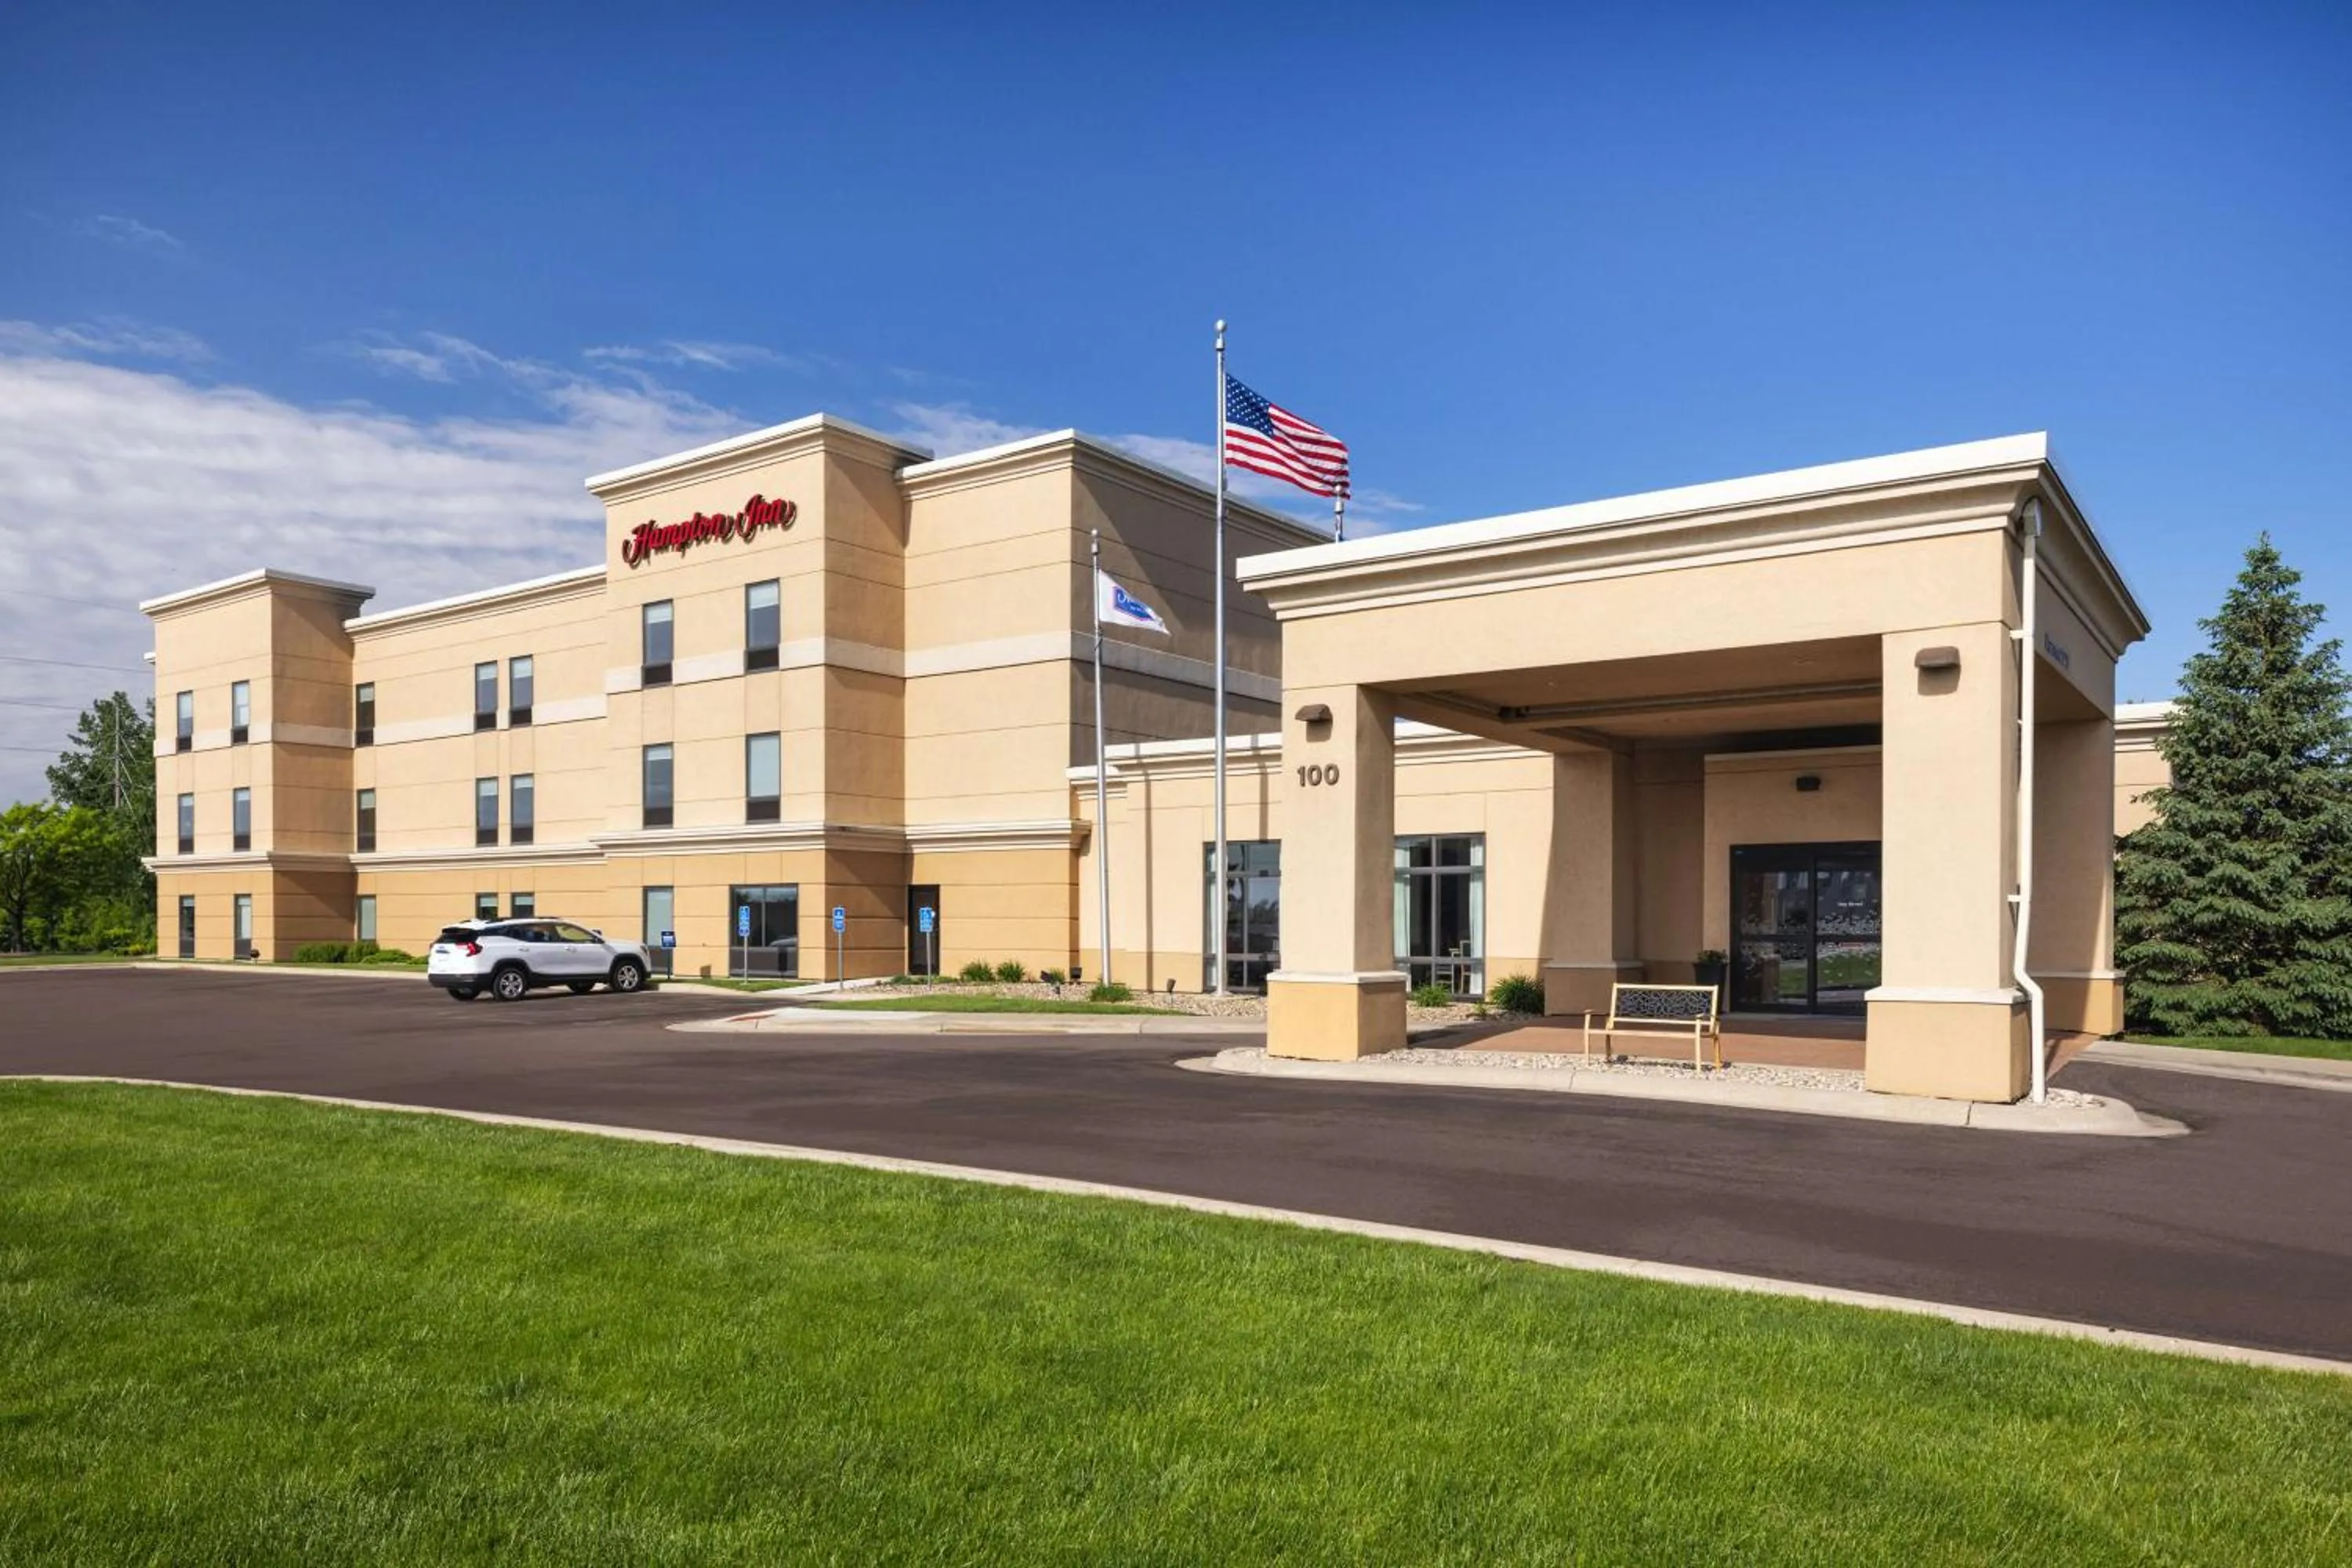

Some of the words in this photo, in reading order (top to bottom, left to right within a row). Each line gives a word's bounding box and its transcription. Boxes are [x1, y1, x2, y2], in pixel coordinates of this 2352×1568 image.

[622, 512, 735, 564] Hampton
[735, 494, 796, 539] Inn
[1297, 764, 1339, 787] 100
